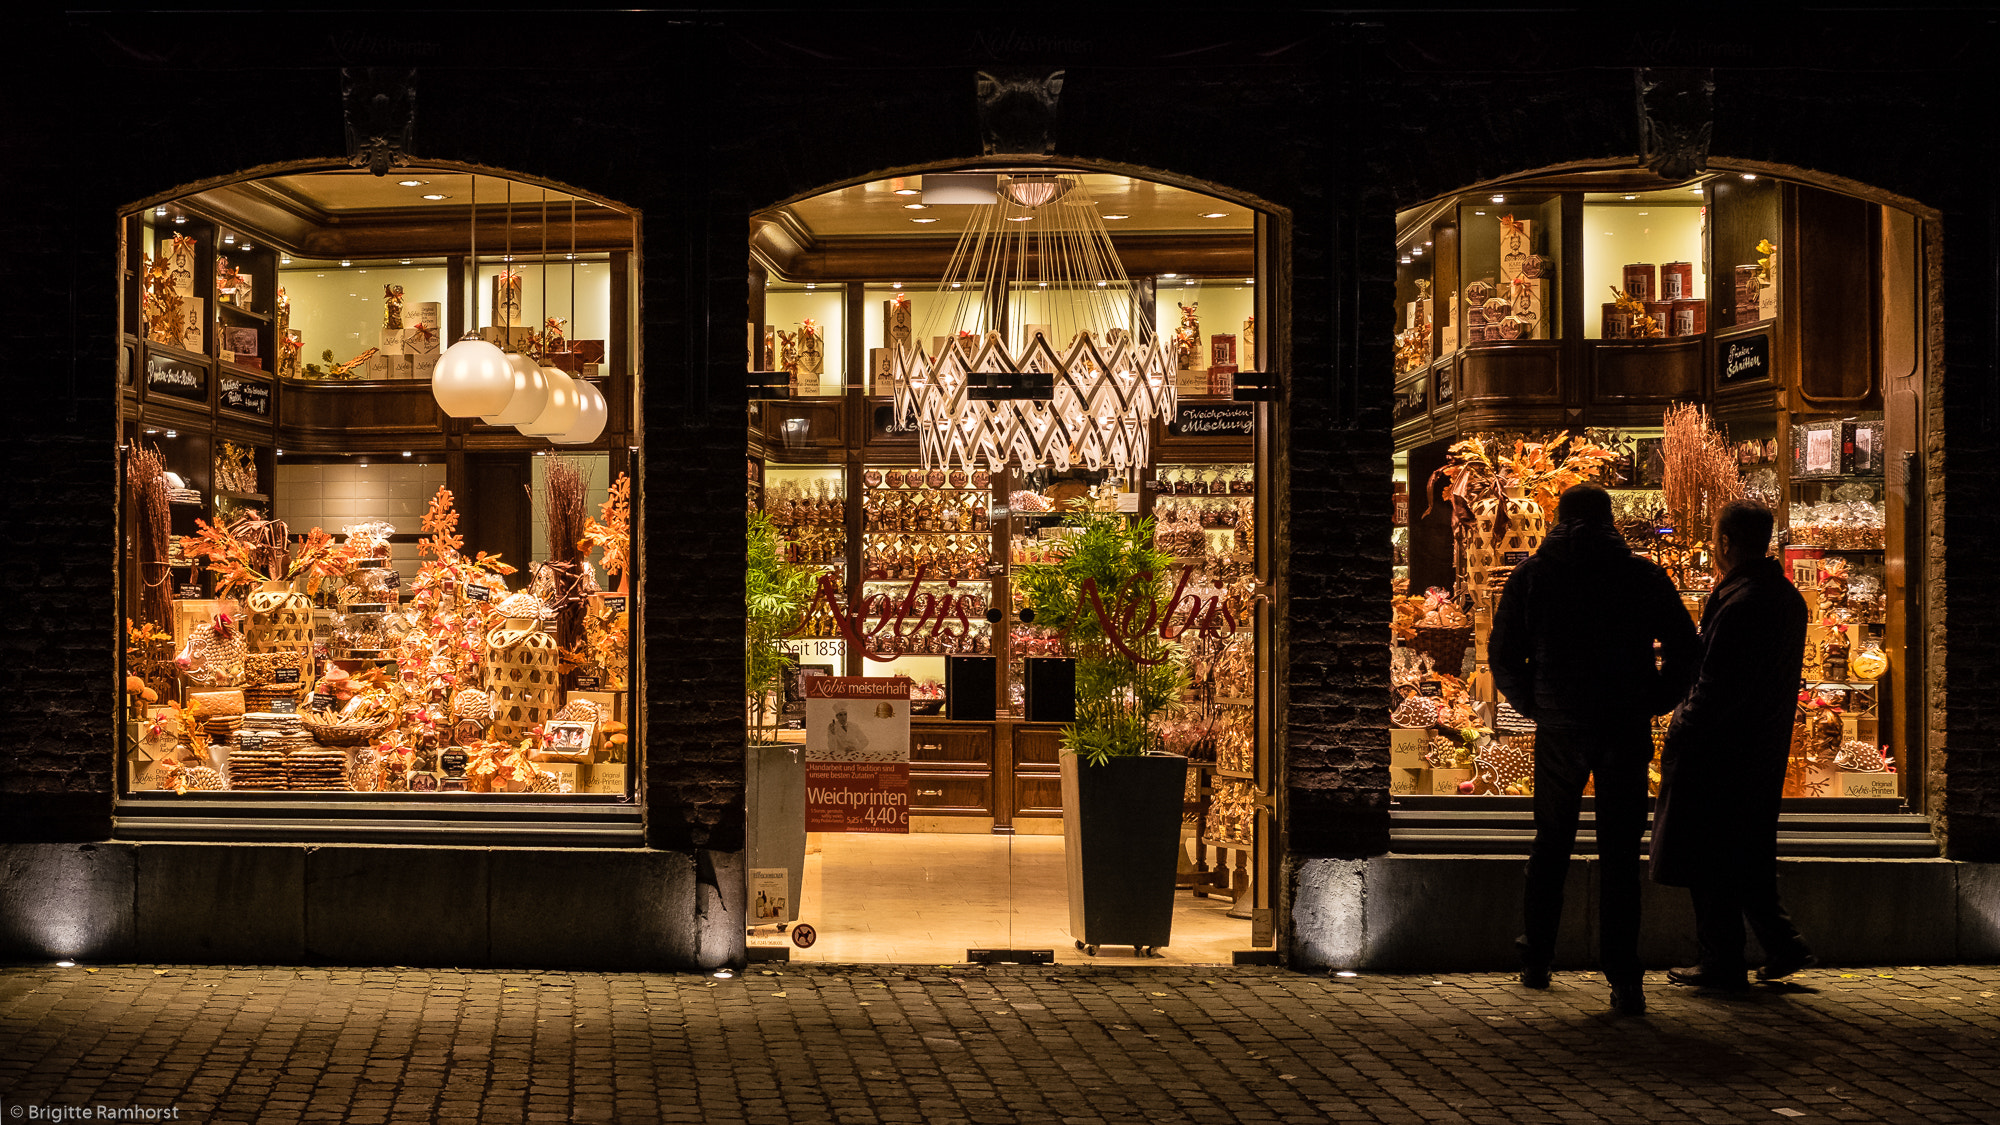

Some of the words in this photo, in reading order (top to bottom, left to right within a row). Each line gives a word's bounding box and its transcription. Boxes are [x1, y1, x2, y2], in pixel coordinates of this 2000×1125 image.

[1183, 408, 1253, 420] Weichprinten-
[1181, 419, 1254, 434] Mischung
[782, 564, 978, 662] Nobis
[1053, 564, 1237, 664] Nobis
[784, 640, 810, 656] Seit
[814, 640, 846, 656] 1858
[811, 679, 846, 697] Nobis
[848, 681, 908, 695] meisterhaft
[830, 771, 851, 779] besten
[844, 763, 855, 771] und
[856, 764, 881, 772] Tradition
[882, 764, 895, 772] sind
[807, 786, 907, 810] Weichprinten
[864, 807, 897, 826] 4,40
[900, 811, 908, 825] €
